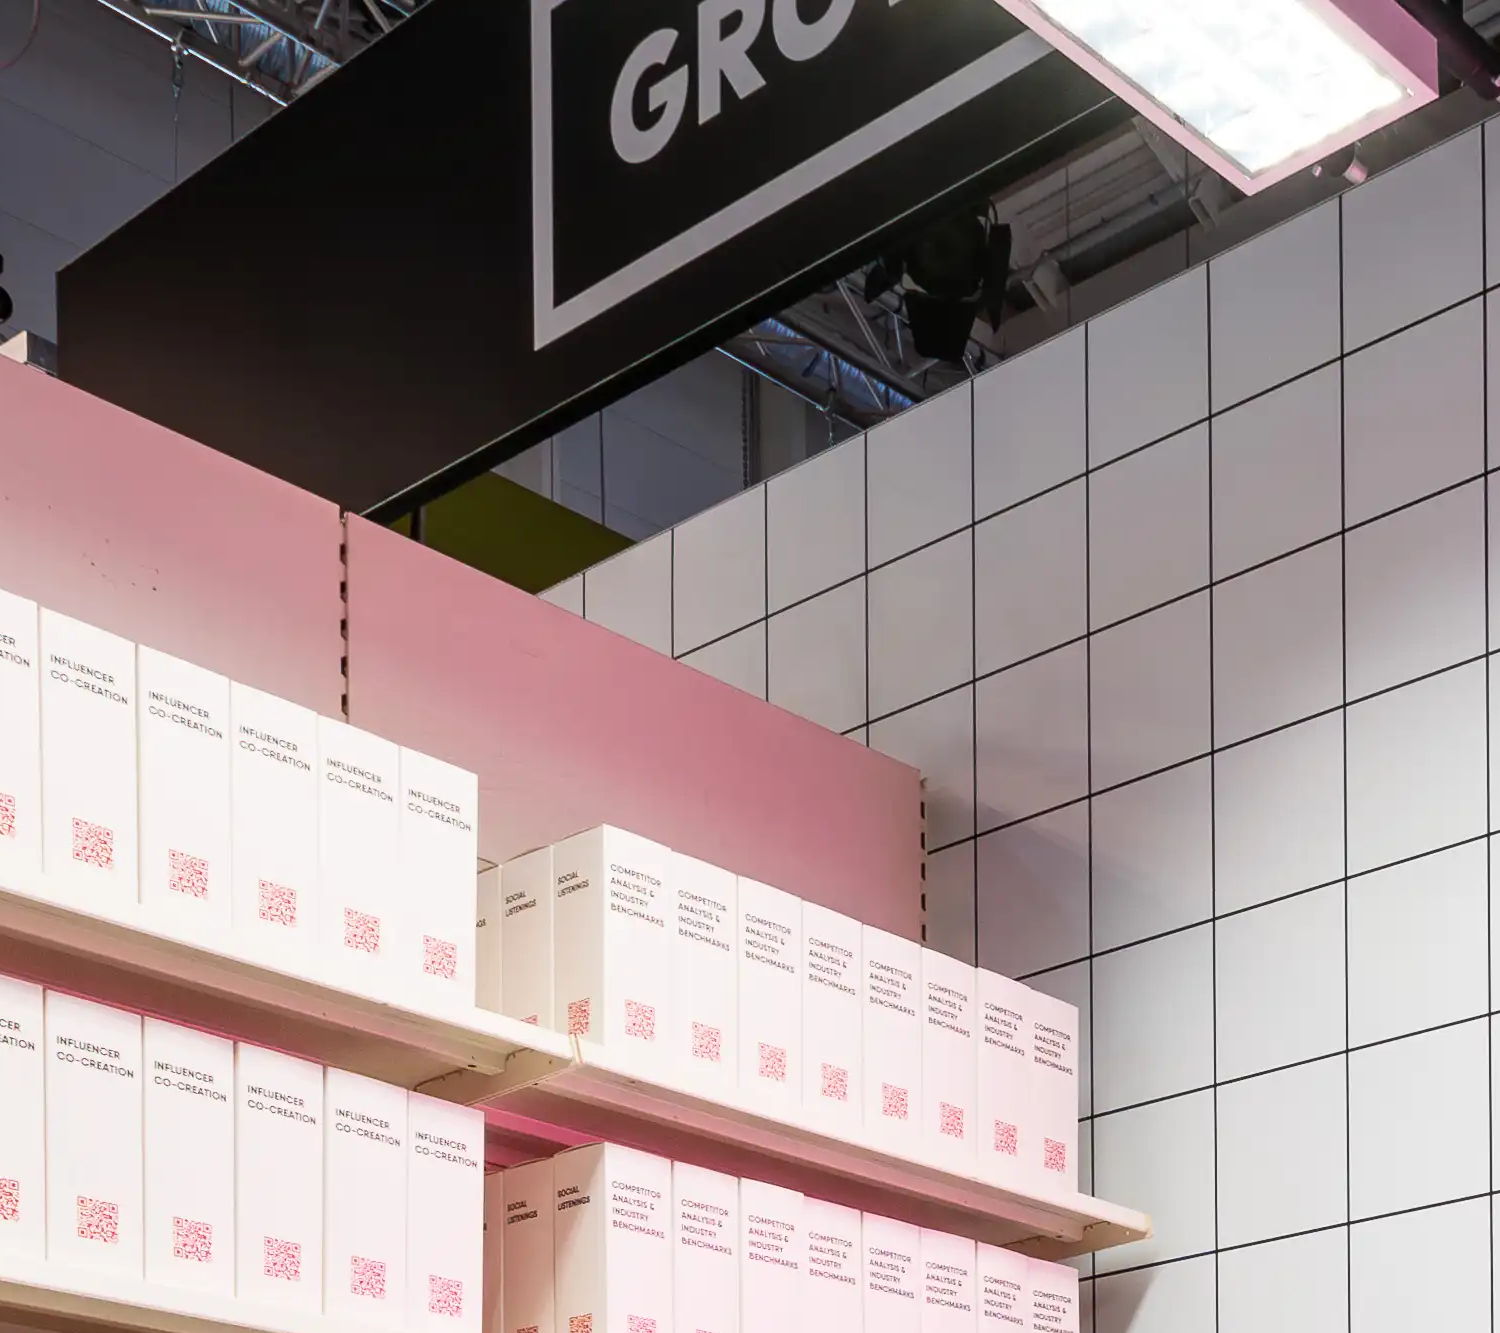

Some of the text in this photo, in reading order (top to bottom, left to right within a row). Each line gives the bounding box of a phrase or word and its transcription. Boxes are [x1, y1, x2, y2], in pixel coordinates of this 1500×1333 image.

[50, 653, 116, 687] INFLUENCER
[50, 669, 129, 706] CO-CREATION
[238, 725, 298, 753] INFLUENCER
[238, 739, 311, 772] CO-CREATION
[557, 870, 580, 886] SOCIAL
[609, 863, 662, 887] COMPETITOR
[610, 876, 648, 896] ANALYSIS
[557, 878, 590, 898] LISTENINGS
[610, 889, 649, 909] INDUSTRY
[610, 902, 665, 928] BENCHMARKS
[744, 912, 792, 936] COMPETITOR
[745, 925, 779, 944] ANALYSIS
[745, 937, 780, 956] INDUSTRY
[744, 949, 795, 974] BENCHMARKS
[56, 1035, 121, 1060] INFLUENCER
[56, 1051, 134, 1079] CO-CREATION
[247, 1084, 305, 1108] INFLUENCER
[247, 1099, 317, 1125] CO-CREATION
[557, 1185, 581, 1199] SOCIAL
[611, 1180, 662, 1199] COMPETITOR
[557, 1195, 591, 1212] LISTENINGS
[611, 1193, 648, 1209] ANALYSIS
[612, 1207, 649, 1222] INDUSTRY
[612, 1219, 665, 1240] BENCHMARKS
